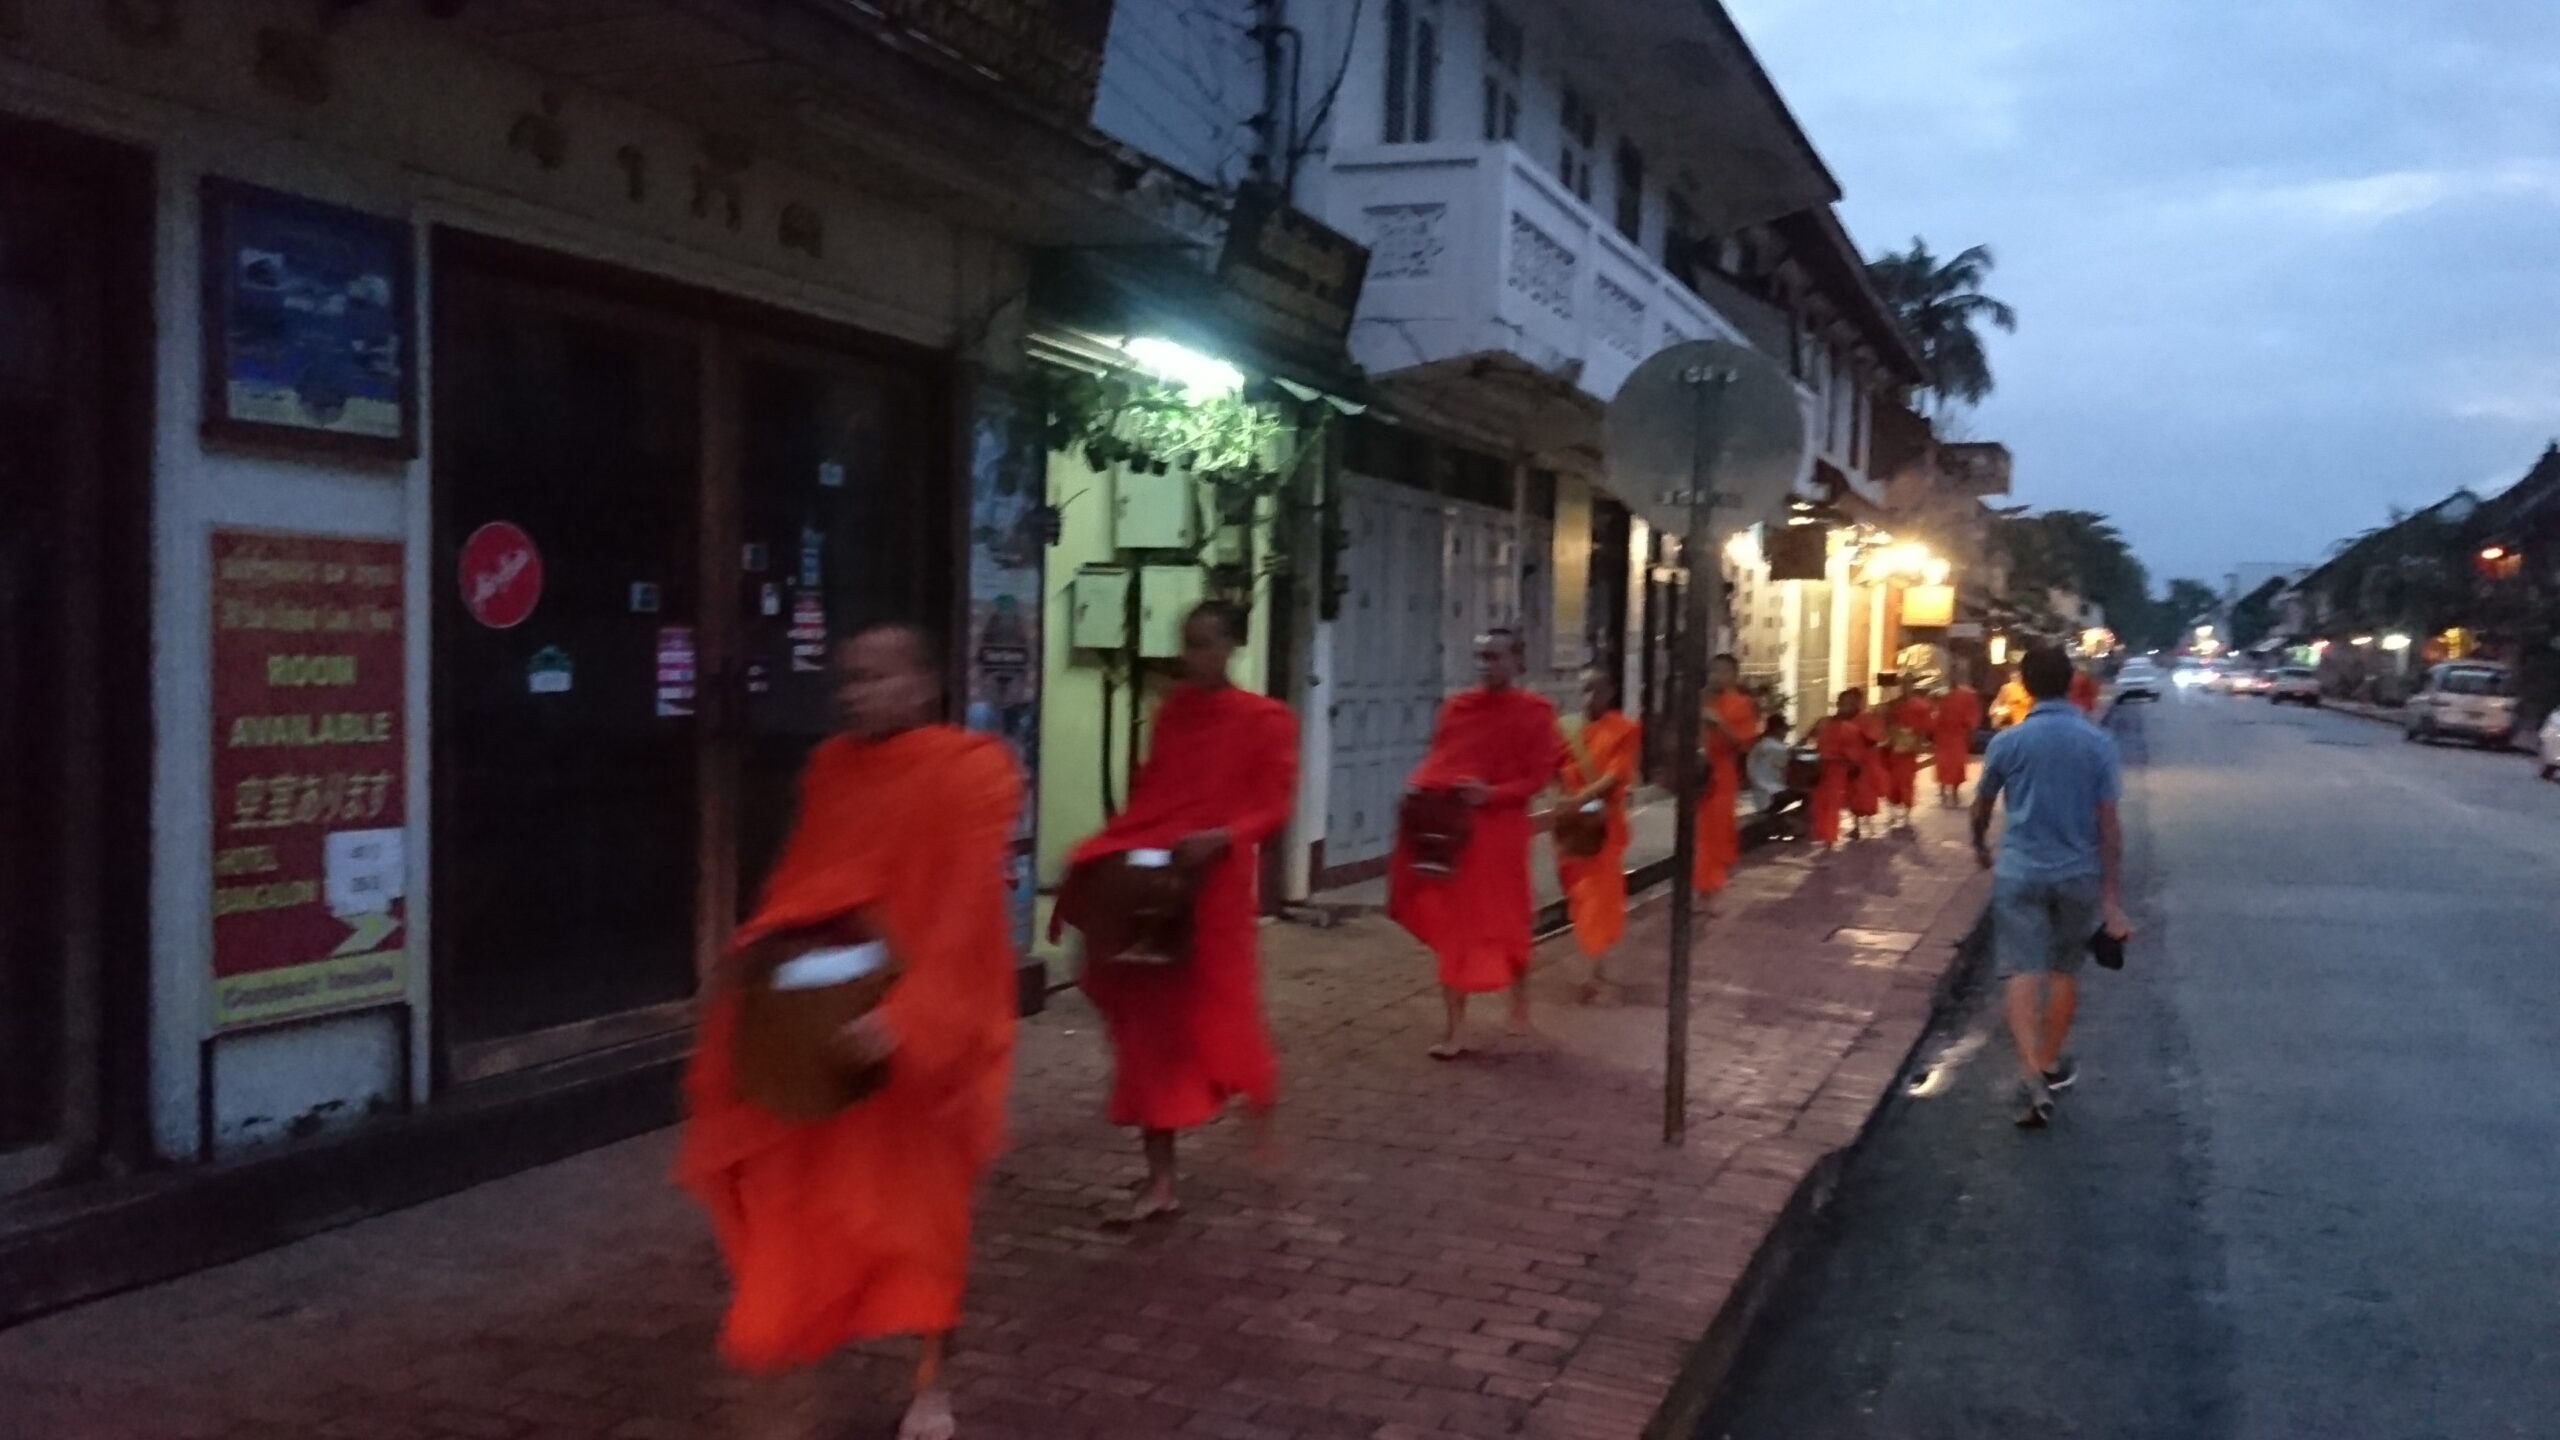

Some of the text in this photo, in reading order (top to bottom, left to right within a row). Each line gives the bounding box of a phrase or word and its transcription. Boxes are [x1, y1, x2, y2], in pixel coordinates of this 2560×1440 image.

[267, 654, 358, 687] ROOM
[229, 711, 394, 748] AVAILABLE
[227, 768, 396, 830] 空室あります
